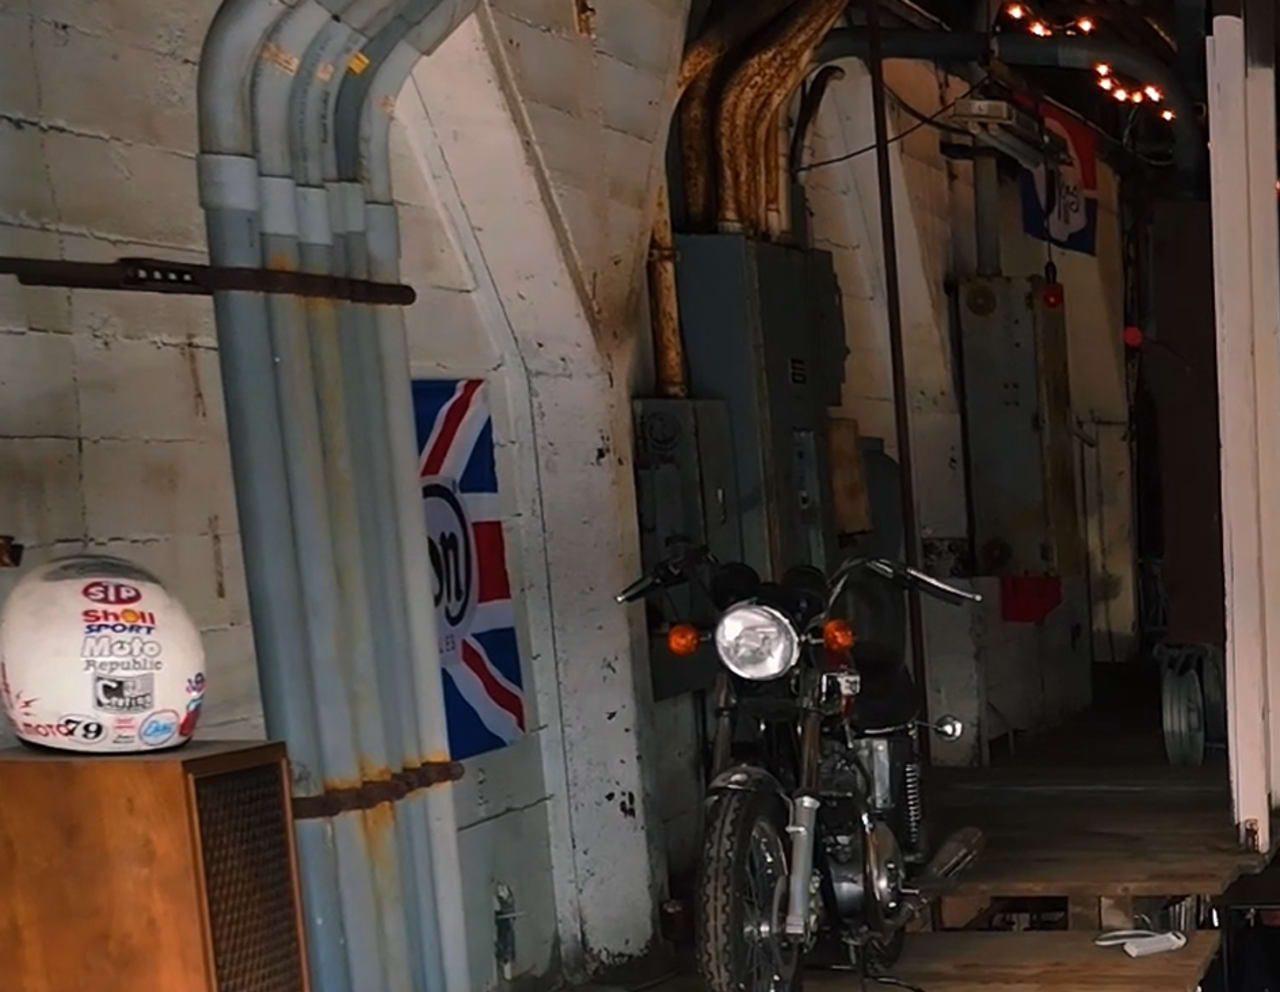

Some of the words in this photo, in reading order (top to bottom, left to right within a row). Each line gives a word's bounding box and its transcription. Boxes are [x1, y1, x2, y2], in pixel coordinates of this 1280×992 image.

[87, 582, 137, 603] STP
[84, 623, 156, 635] SPORT
[81, 635, 162, 658] Moto
[83, 659, 164, 674] Republic
[64, 718, 103, 740] 79
